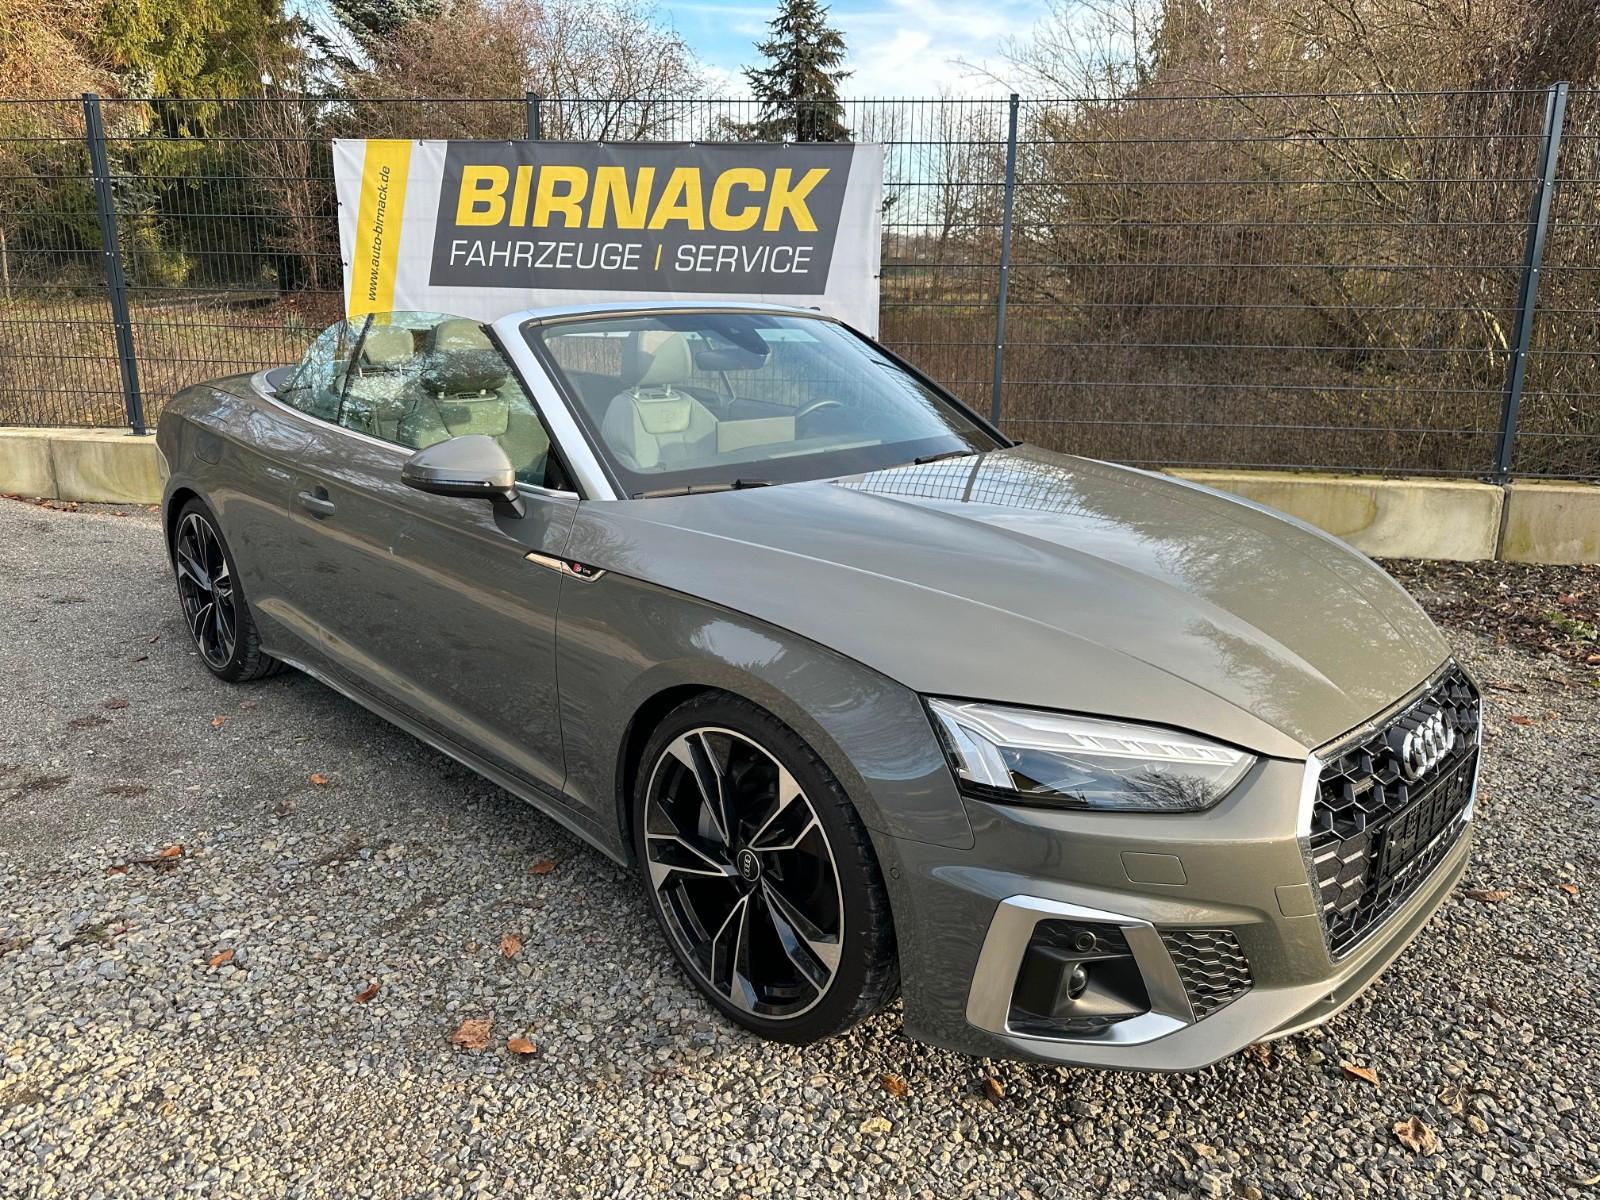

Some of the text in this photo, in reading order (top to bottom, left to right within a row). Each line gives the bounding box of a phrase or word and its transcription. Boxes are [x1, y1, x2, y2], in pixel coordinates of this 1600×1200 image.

[455, 165, 829, 232] BIRNACK
[368, 165, 391, 301] www.auto-birnack.de
[449, 239, 815, 274] FAHRZEUGE SERVICE
